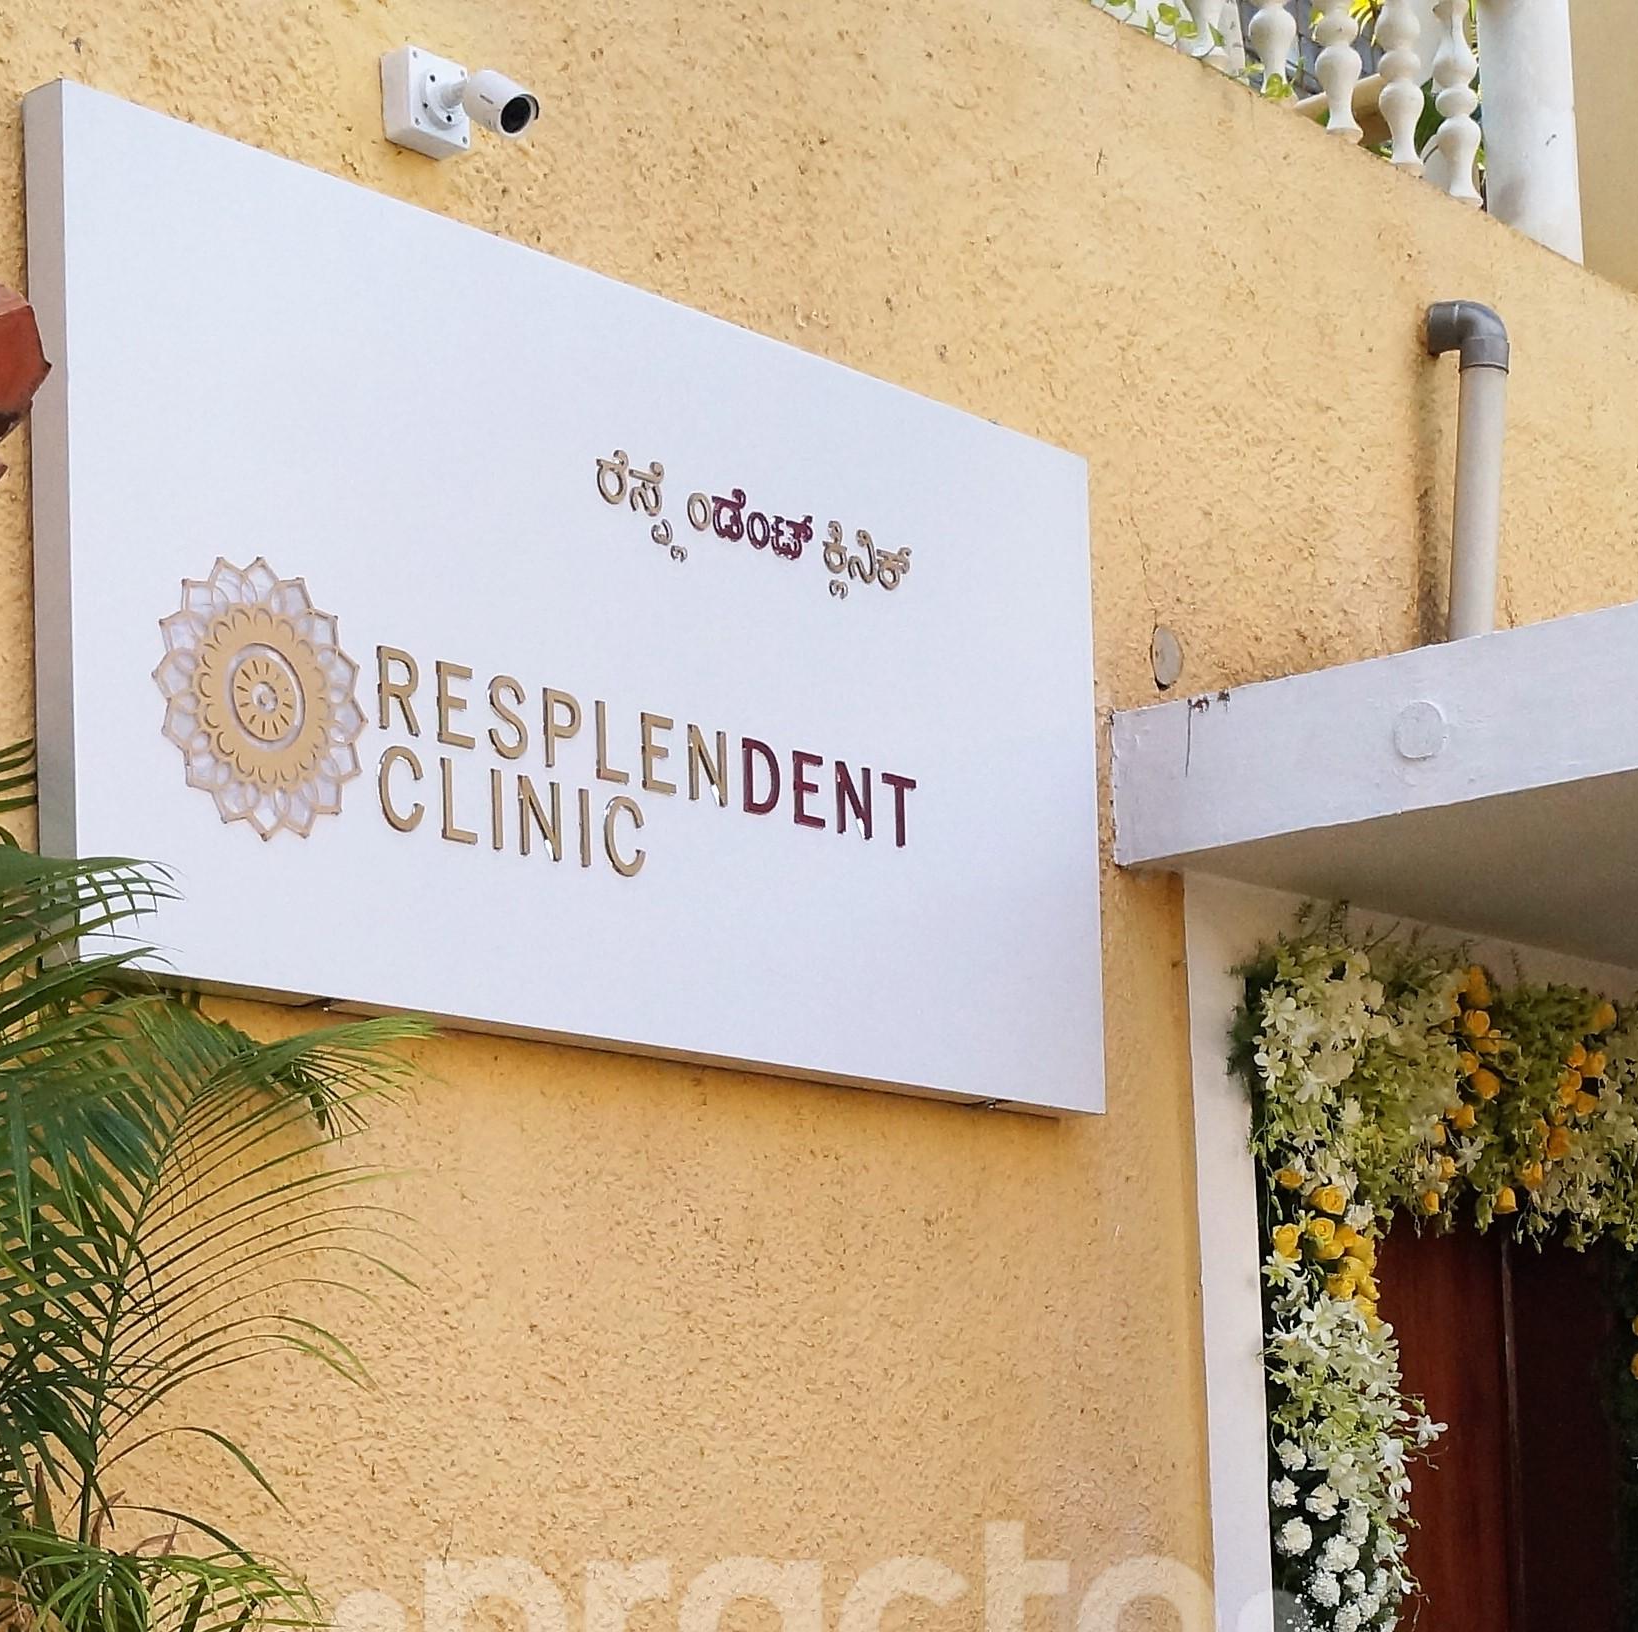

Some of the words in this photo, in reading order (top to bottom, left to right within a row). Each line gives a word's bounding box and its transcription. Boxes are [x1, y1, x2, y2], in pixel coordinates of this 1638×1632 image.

[823, 520, 912, 600] ಕ್ಲಿನಿಕ್
[375, 645, 917, 848] RESPLENDENT
[376, 745, 648, 877] CLINIC
